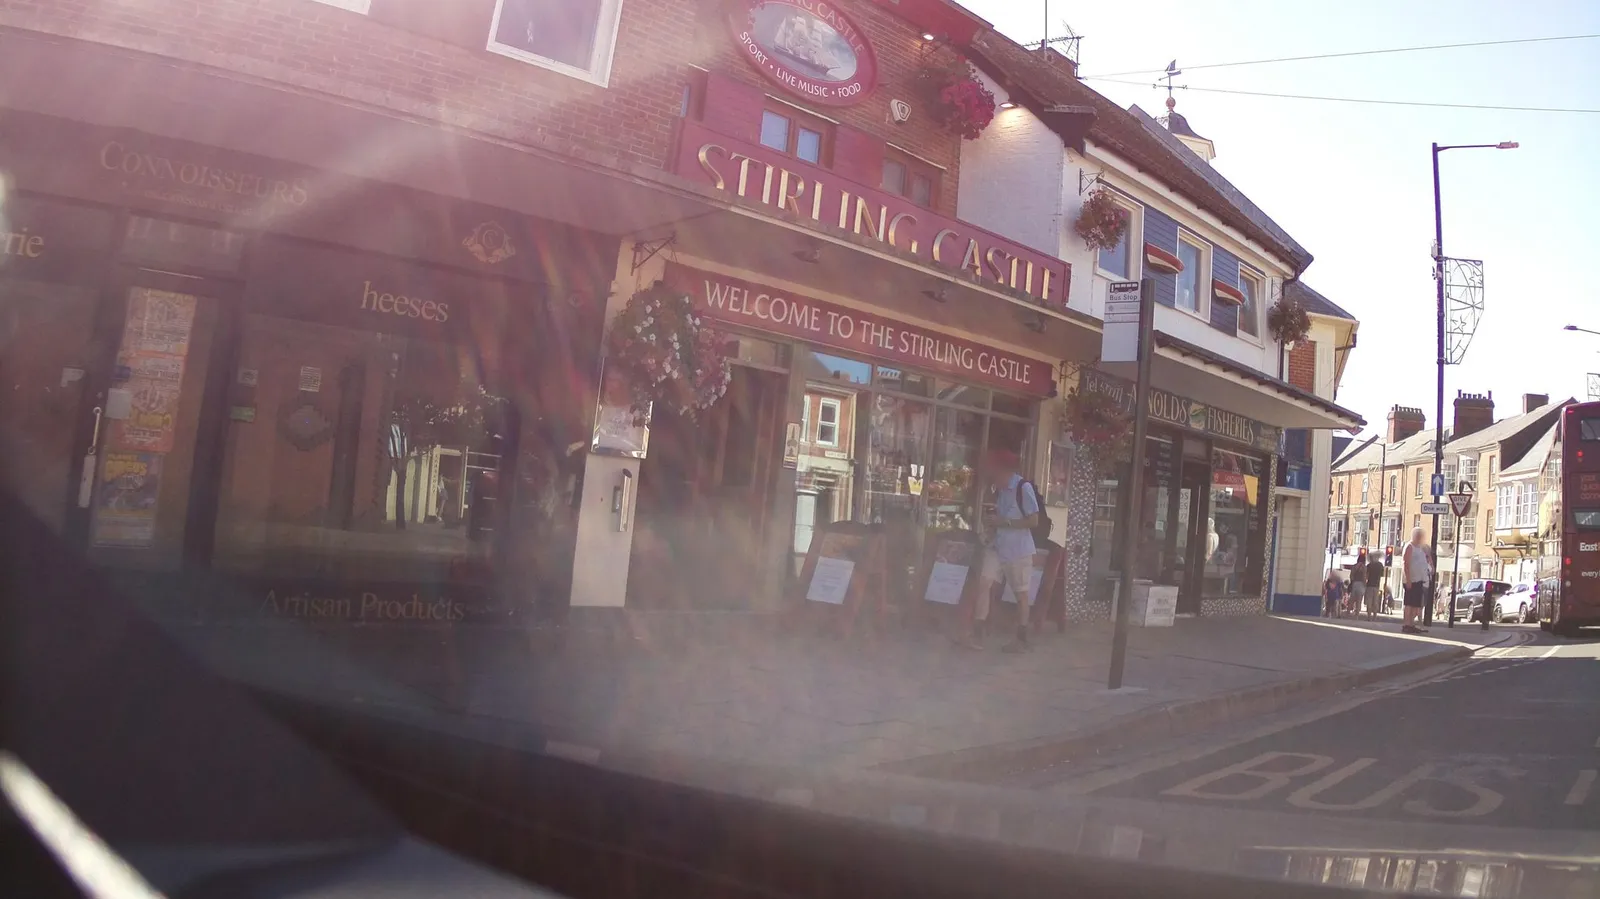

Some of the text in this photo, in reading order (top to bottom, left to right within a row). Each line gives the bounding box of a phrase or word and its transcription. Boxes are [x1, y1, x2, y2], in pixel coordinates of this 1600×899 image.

[817, 2, 865, 57] CASTLE
[740, 31, 861, 98] SPORT LIVE MUSIC FOOD
[698, 143, 918, 254] STIRLING
[360, 280, 449, 323] heeses
[1123, 293, 1138, 302] Stop
[703, 280, 1031, 385] WELCOME TO THE STIRLING CASTLE
[1207, 407, 1254, 445] FISHERIES
[259, 588, 465, 621] Artisan Products
[1160, 750, 1529, 818] BUS
